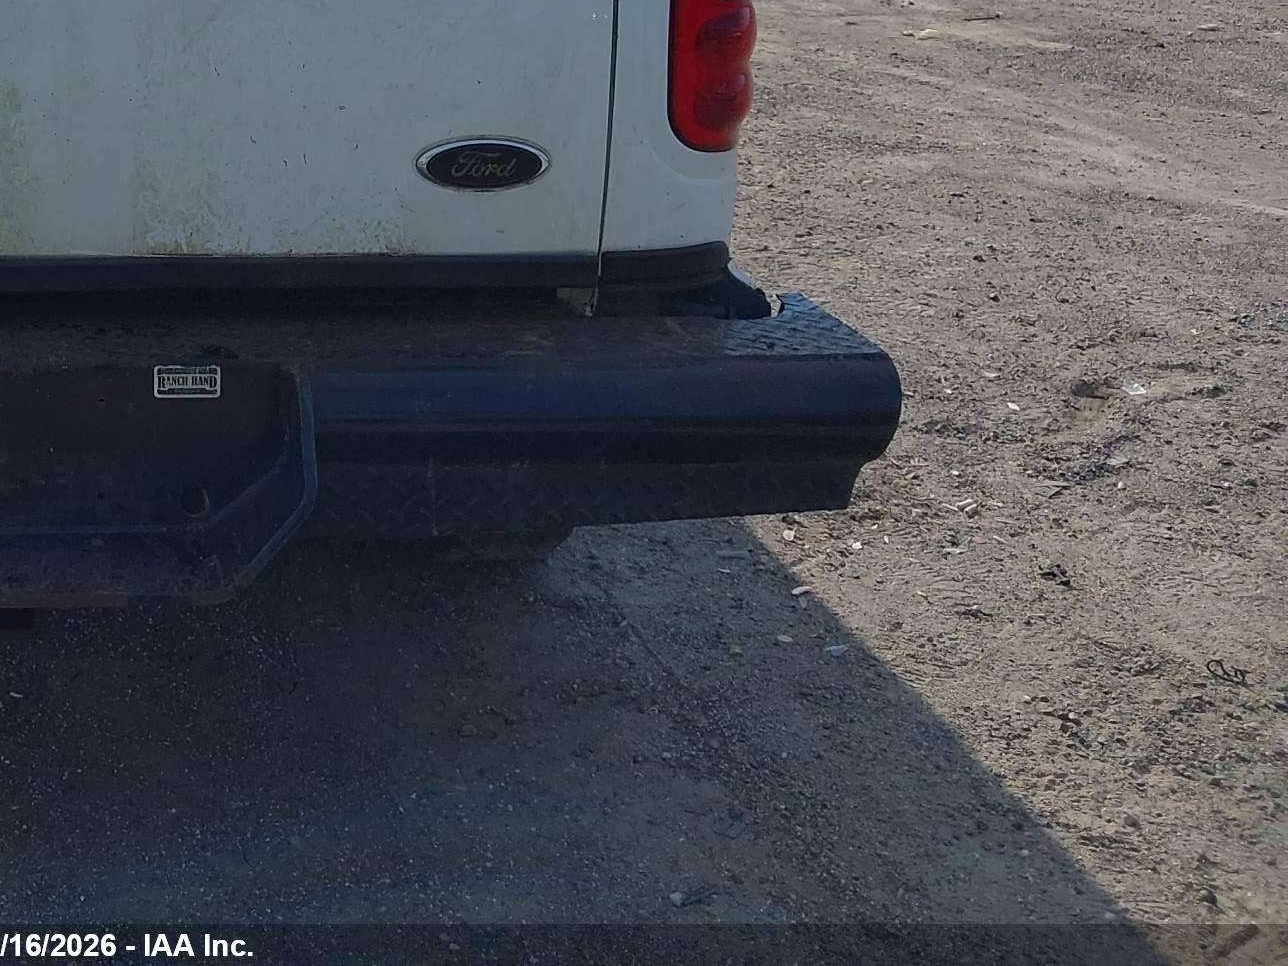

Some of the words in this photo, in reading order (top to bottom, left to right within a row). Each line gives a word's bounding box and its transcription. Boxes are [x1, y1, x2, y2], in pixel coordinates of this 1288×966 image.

[452, 150, 517, 177] Ford
[157, 376, 189, 389] RANCH
[191, 376, 218, 389] HAND
